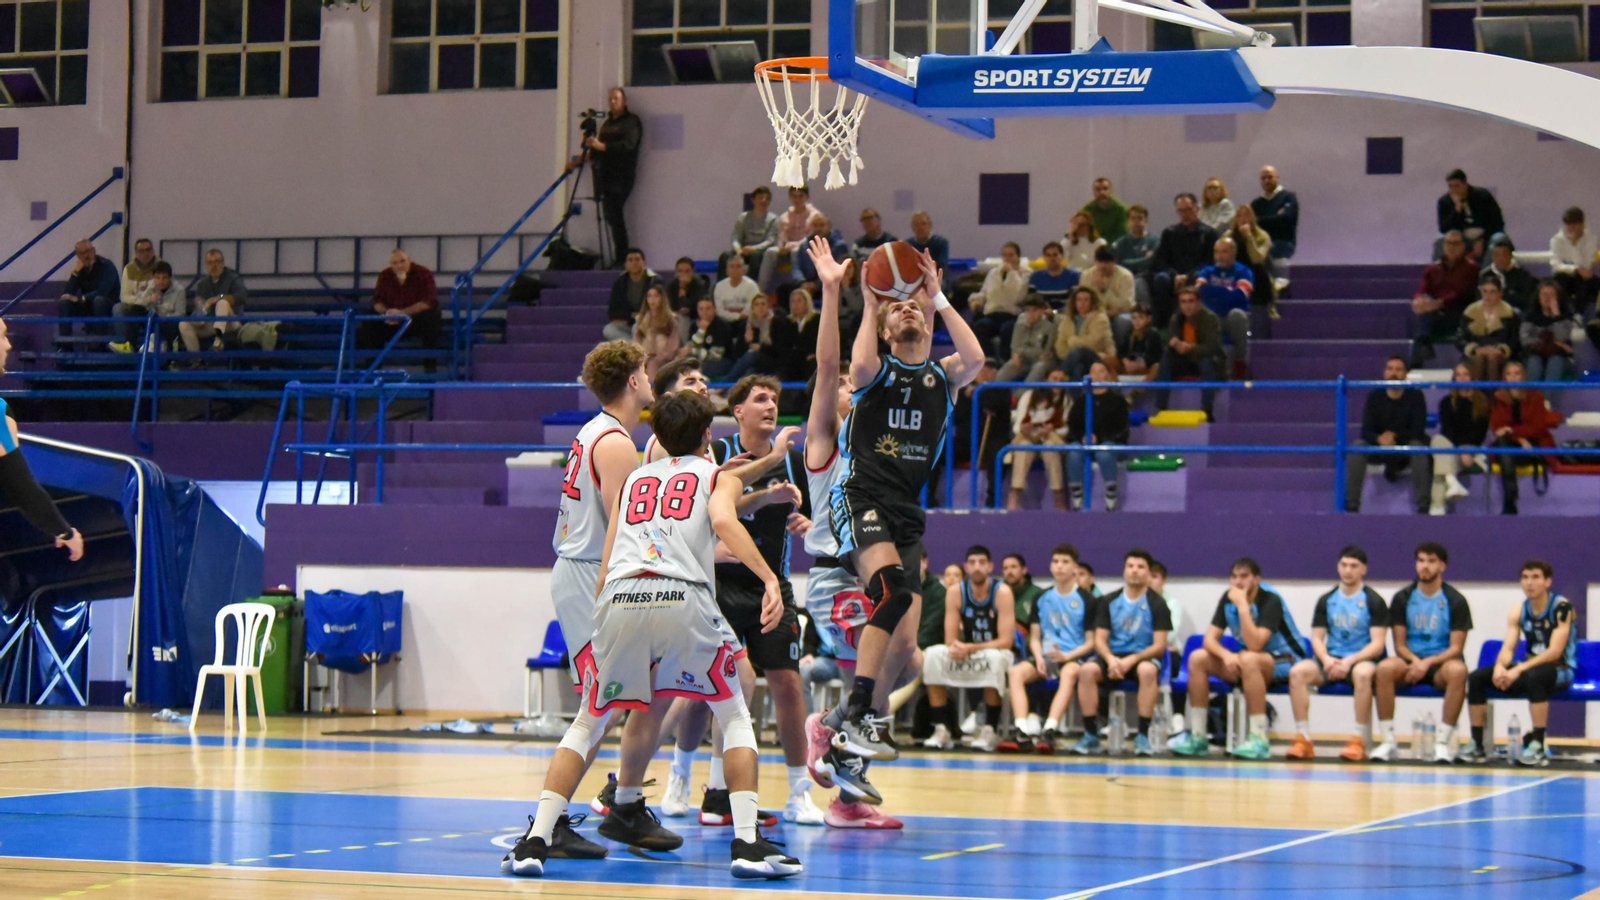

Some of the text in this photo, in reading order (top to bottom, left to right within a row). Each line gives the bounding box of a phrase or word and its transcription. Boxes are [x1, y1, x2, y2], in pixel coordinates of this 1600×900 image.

[974, 67, 1153, 92] SPORT SYSTEM
[901, 387, 912, 405] 7
[888, 408, 923, 430] ULB
[625, 472, 700, 526] 88
[612, 590, 686, 604] FITNESS PARK
